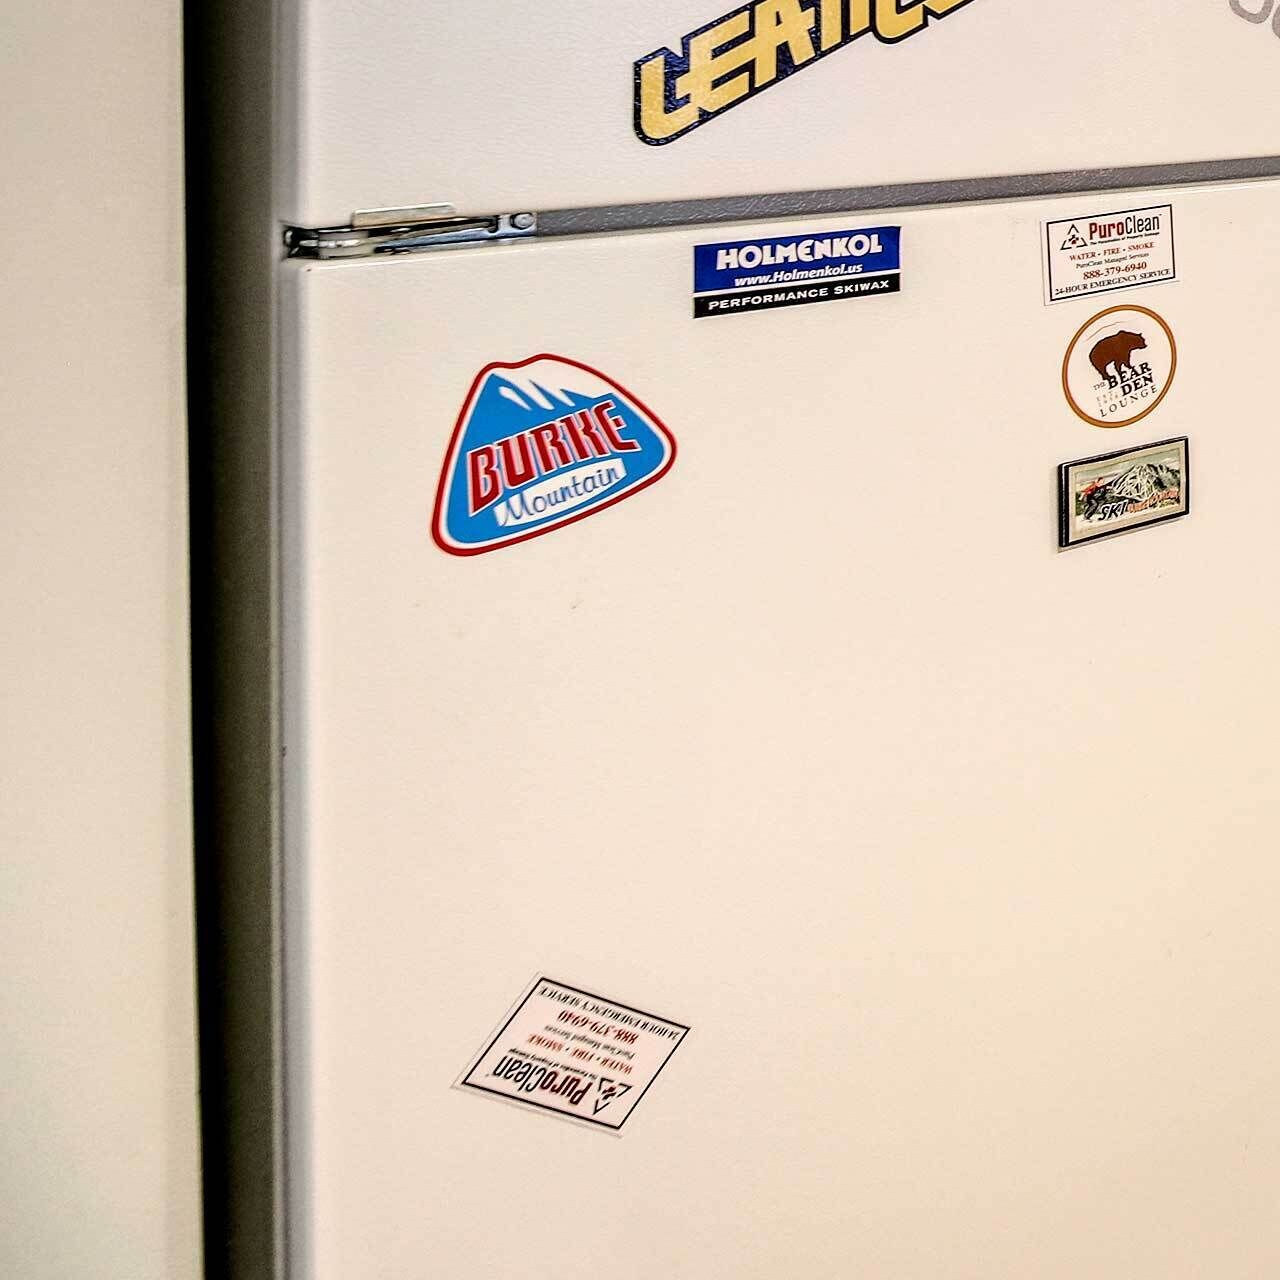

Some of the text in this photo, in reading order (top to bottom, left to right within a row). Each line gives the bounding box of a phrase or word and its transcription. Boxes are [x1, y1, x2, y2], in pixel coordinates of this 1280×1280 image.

[1089, 215, 1160, 240] PuroClean
[716, 234, 882, 270] HOLMENKOL
[1070, 242, 1155, 261] WATER FIRE SMOKE
[1076, 260, 1103, 269] PuroClean
[734, 264, 863, 287] www.Holmenkol.us
[1055, 268, 1170, 295] 24-HOUR EMERGENCY SERVICE
[1083, 261, 1147, 280] 888-379-6940
[708, 280, 889, 310] PERFORMANCE SKIWAX
[1108, 361, 1153, 390] BEAR
[1121, 372, 1154, 396] DEN
[1100, 384, 1158, 417] LOUNGE
[467, 400, 642, 517] BURKE
[499, 466, 621, 526] Mountain
[1098, 499, 1129, 521] SKI
[539, 986, 581, 1008] SERVICE
[581, 999, 641, 1028] EMERGENCY
[557, 1010, 640, 1045] 888-379-6940
[528, 1033, 565, 1052] SMOKE
[493, 1055, 594, 1105] PuroClean
